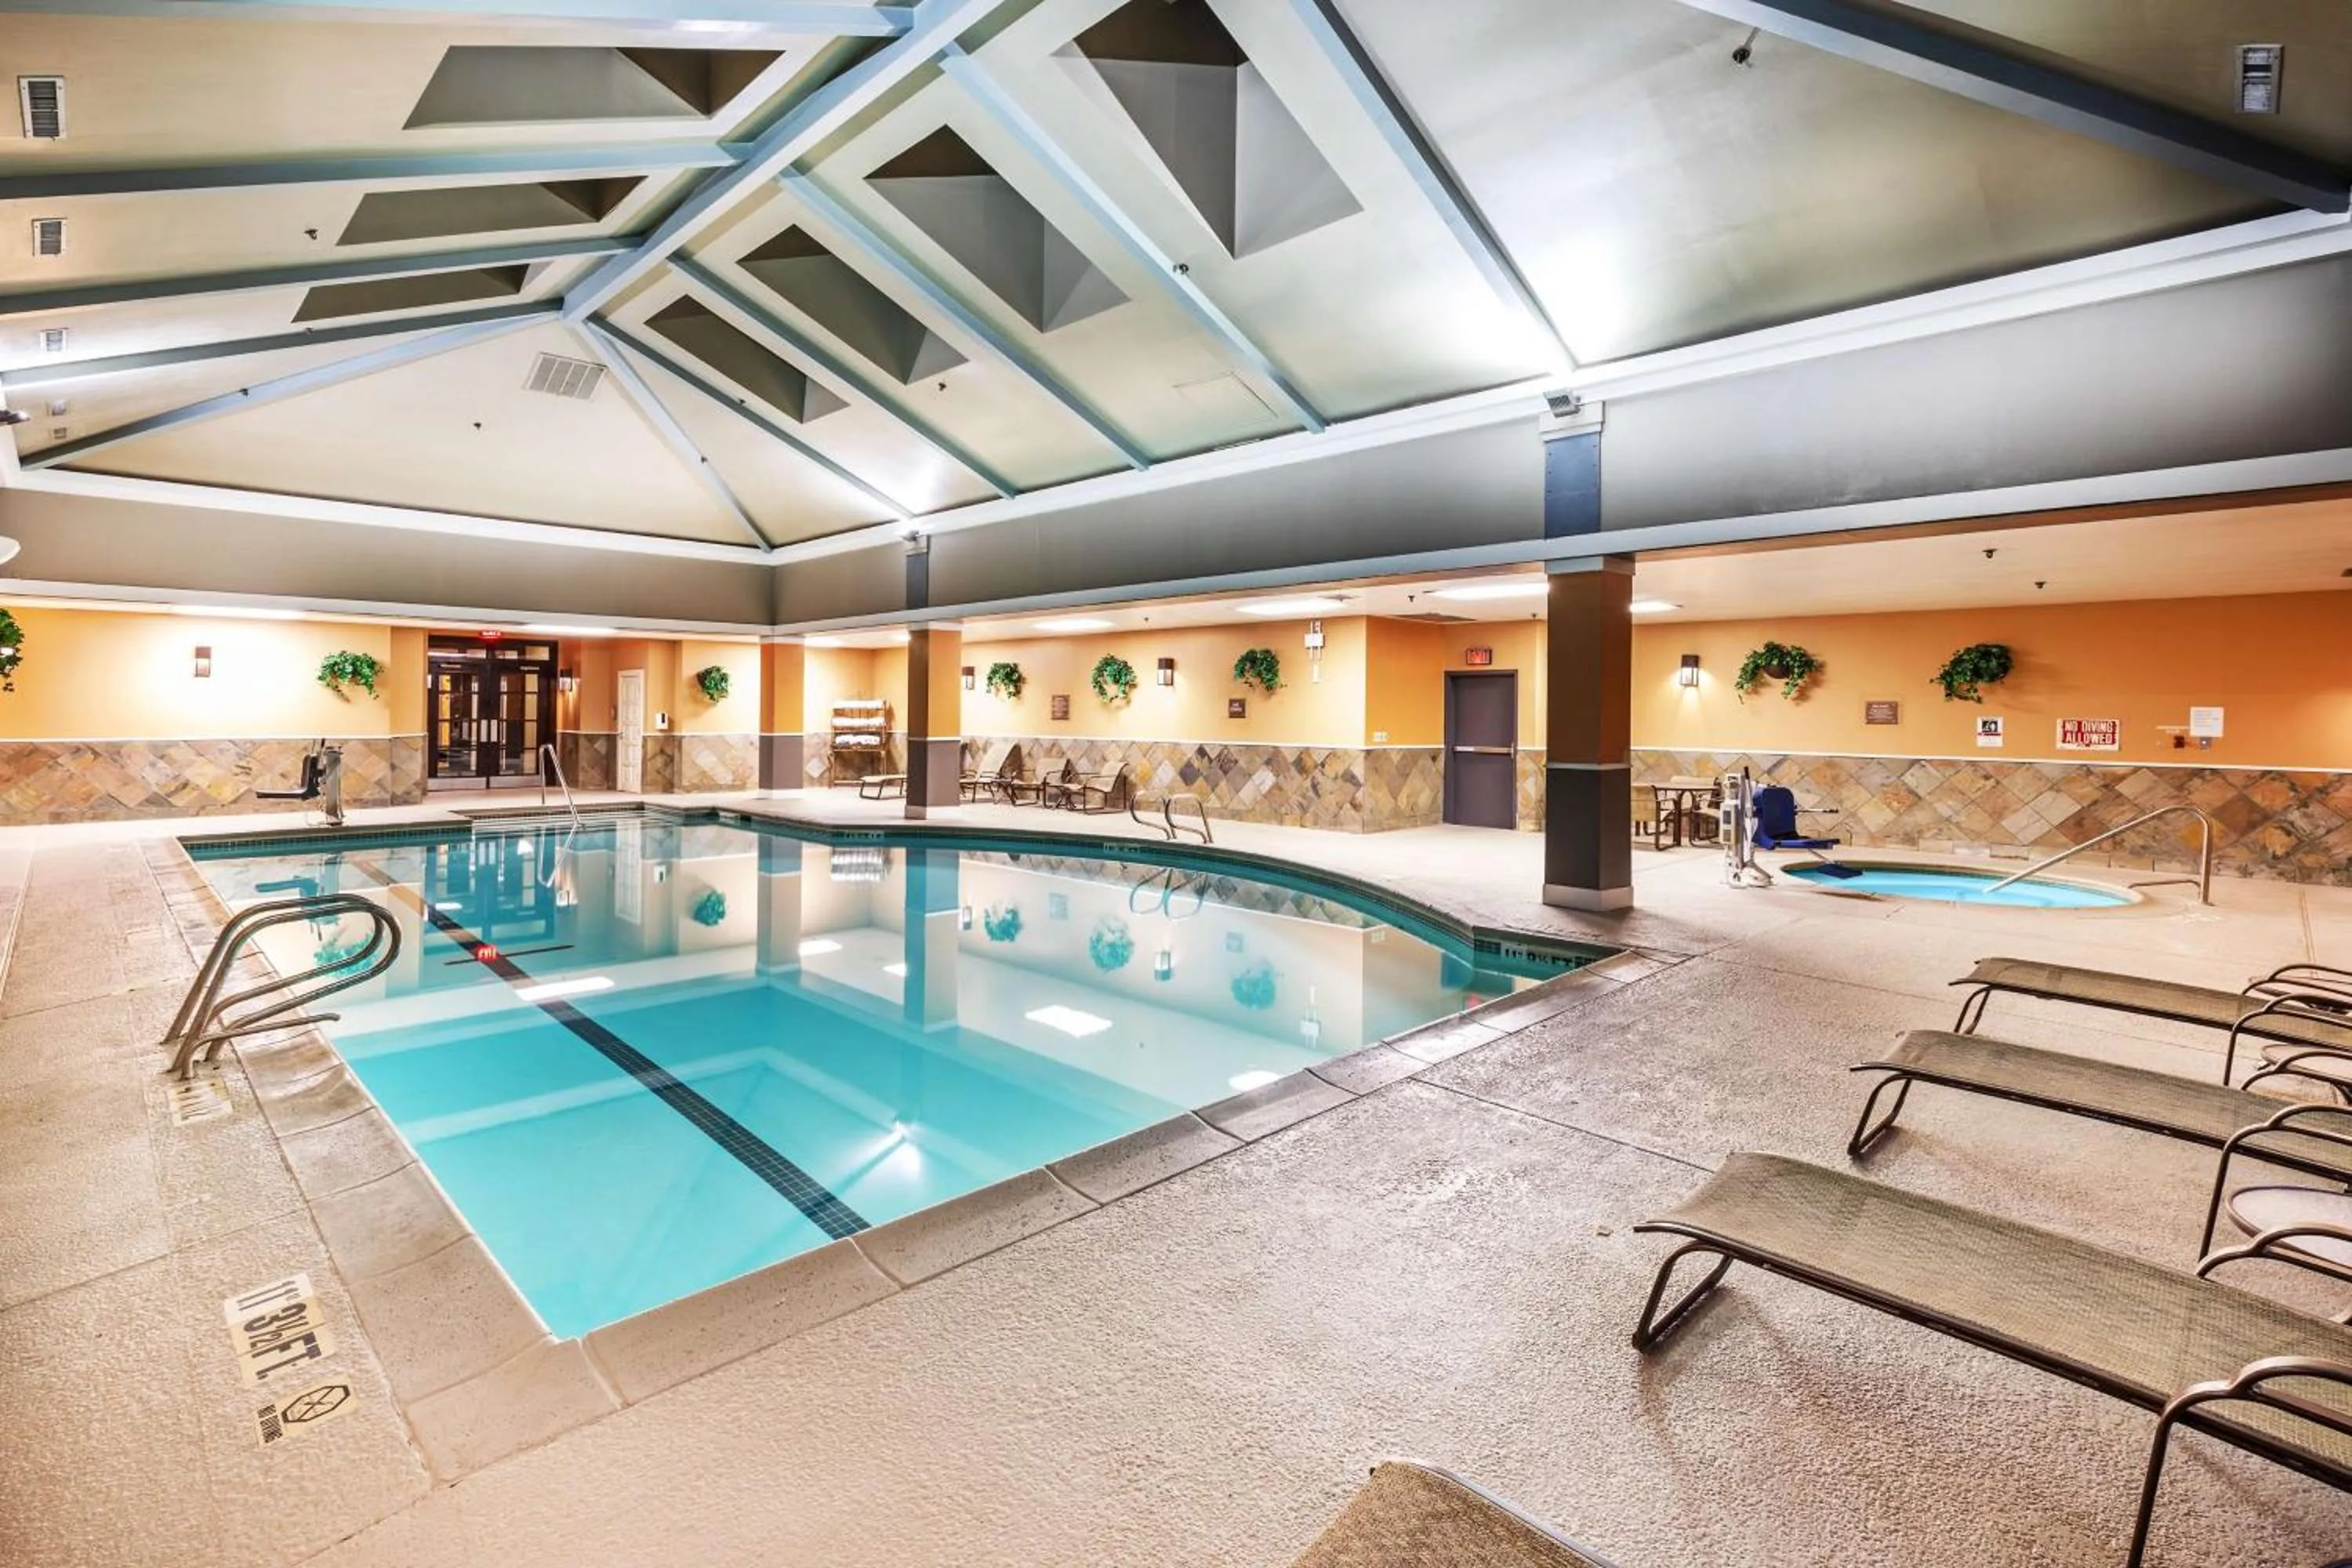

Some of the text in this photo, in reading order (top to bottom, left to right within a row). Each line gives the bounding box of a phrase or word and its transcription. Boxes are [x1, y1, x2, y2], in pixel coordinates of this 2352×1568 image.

[2064, 720, 2113, 733] NO DIVING
[2065, 731, 2113, 745] ALLOWED
